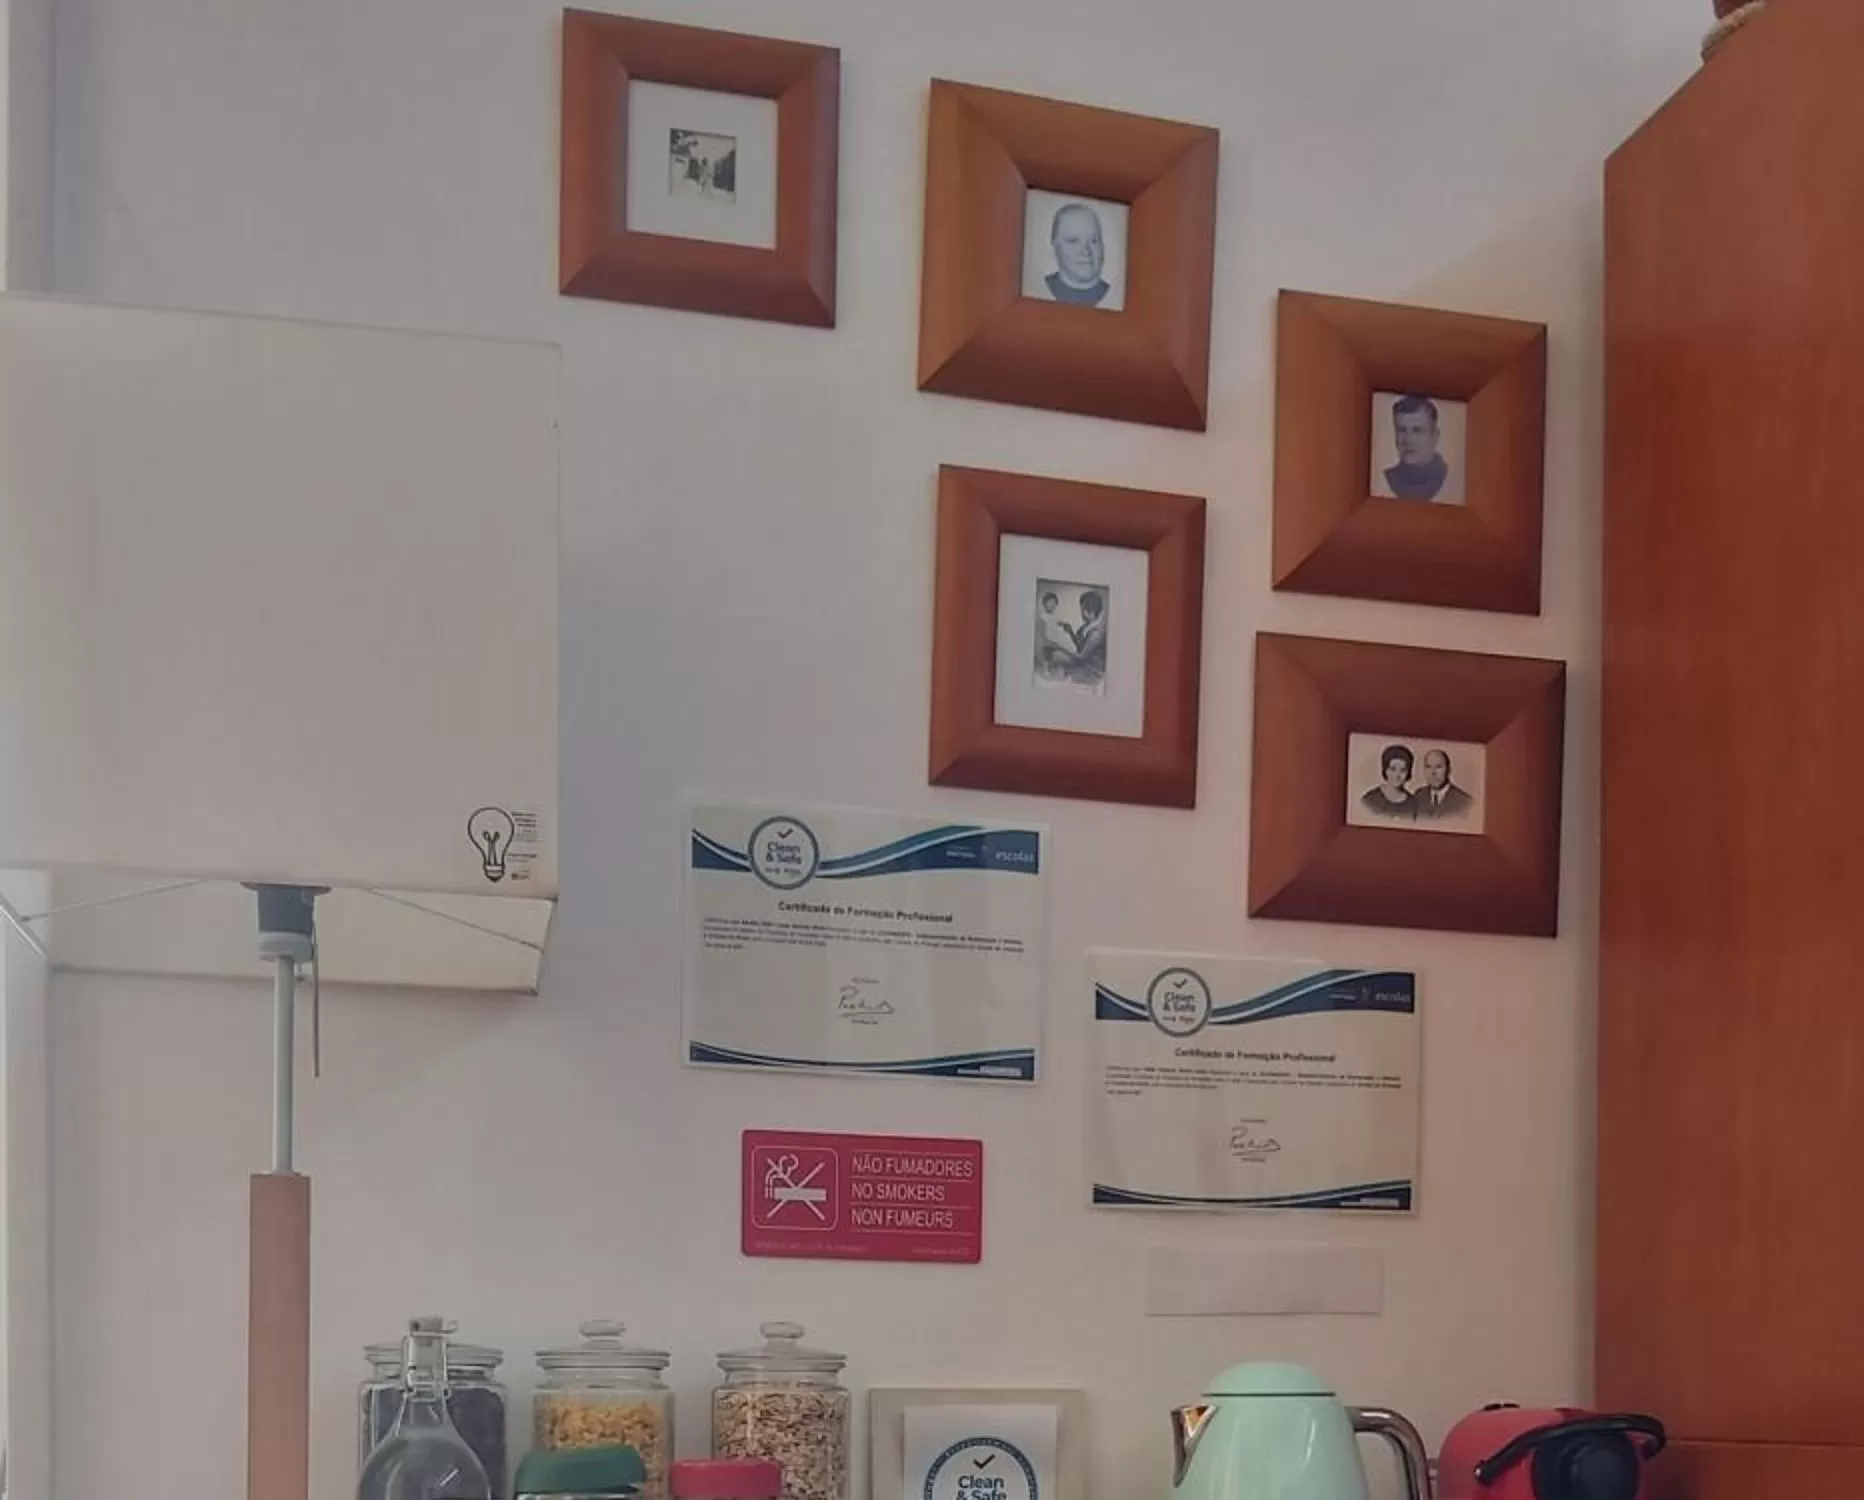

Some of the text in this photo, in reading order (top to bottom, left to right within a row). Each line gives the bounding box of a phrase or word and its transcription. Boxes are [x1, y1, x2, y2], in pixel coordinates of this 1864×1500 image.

[852, 1154, 973, 1177] NÃO FUMADORES
[852, 1183, 945, 1201] NO SMOKERS
[852, 1208, 953, 1228] NON FUMEURS
[958, 1475, 1004, 1489] Clean
